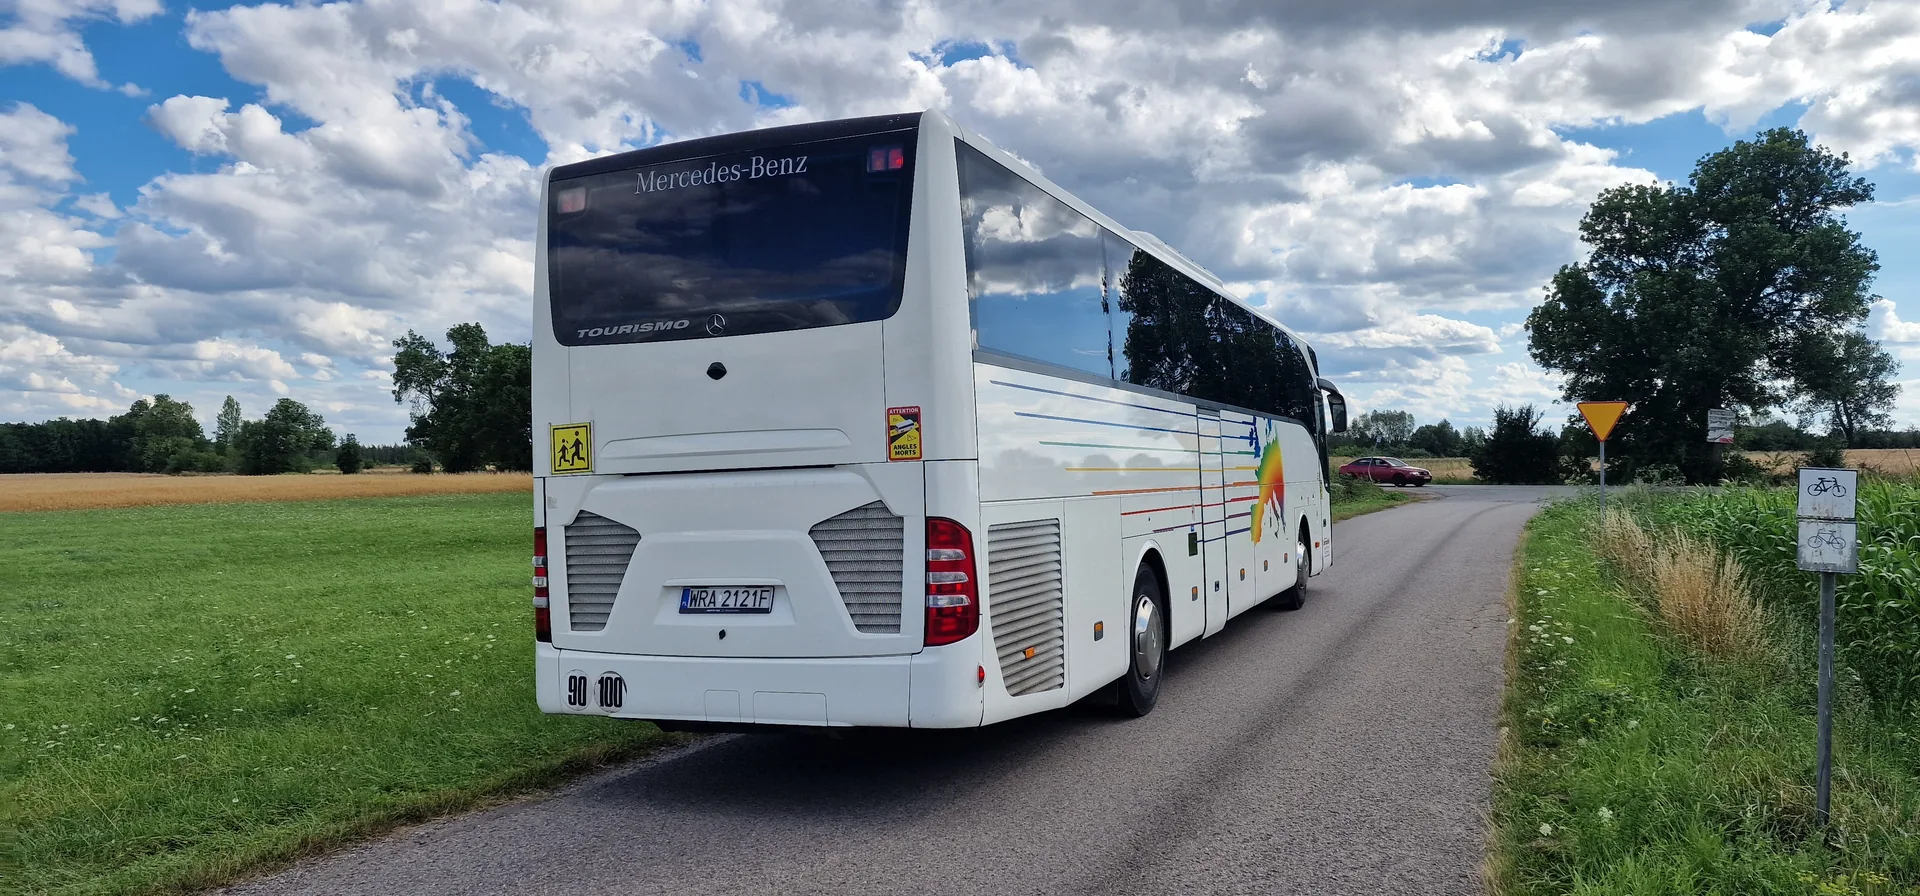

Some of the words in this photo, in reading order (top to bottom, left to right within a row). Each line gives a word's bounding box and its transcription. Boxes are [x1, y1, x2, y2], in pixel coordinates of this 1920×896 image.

[634, 155, 808, 195] Mercedes-Benz
[577, 319, 690, 338] TOURISMO
[689, 589, 716, 607] WRA
[721, 589, 770, 607] 2121F
[568, 675, 587, 706] 90
[597, 676, 623, 707] 100
